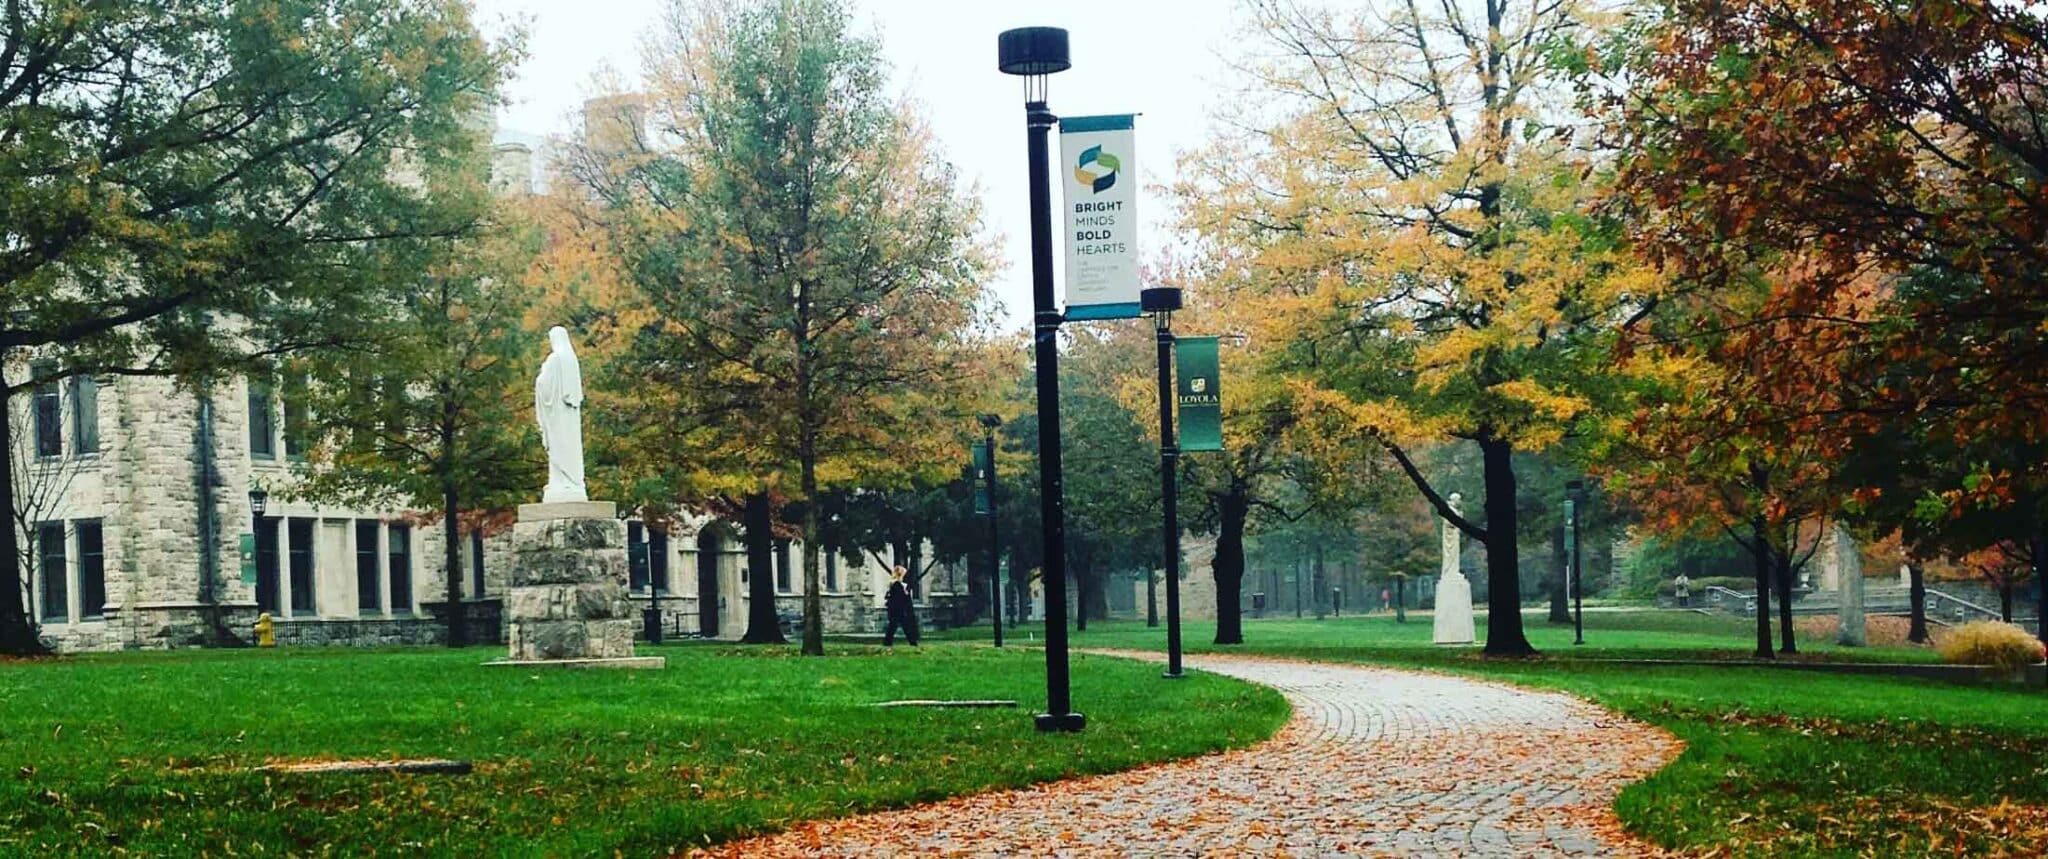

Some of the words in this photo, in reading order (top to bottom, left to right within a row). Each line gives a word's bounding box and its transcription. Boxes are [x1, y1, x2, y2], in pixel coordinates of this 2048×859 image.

[1075, 201, 1123, 213] BRIGHT
[1075, 215, 1115, 226] MINDS
[1076, 229, 1111, 241] BOLD
[1077, 242, 1126, 255] HEARTS
[1179, 395, 1218, 403] LOYOLA
